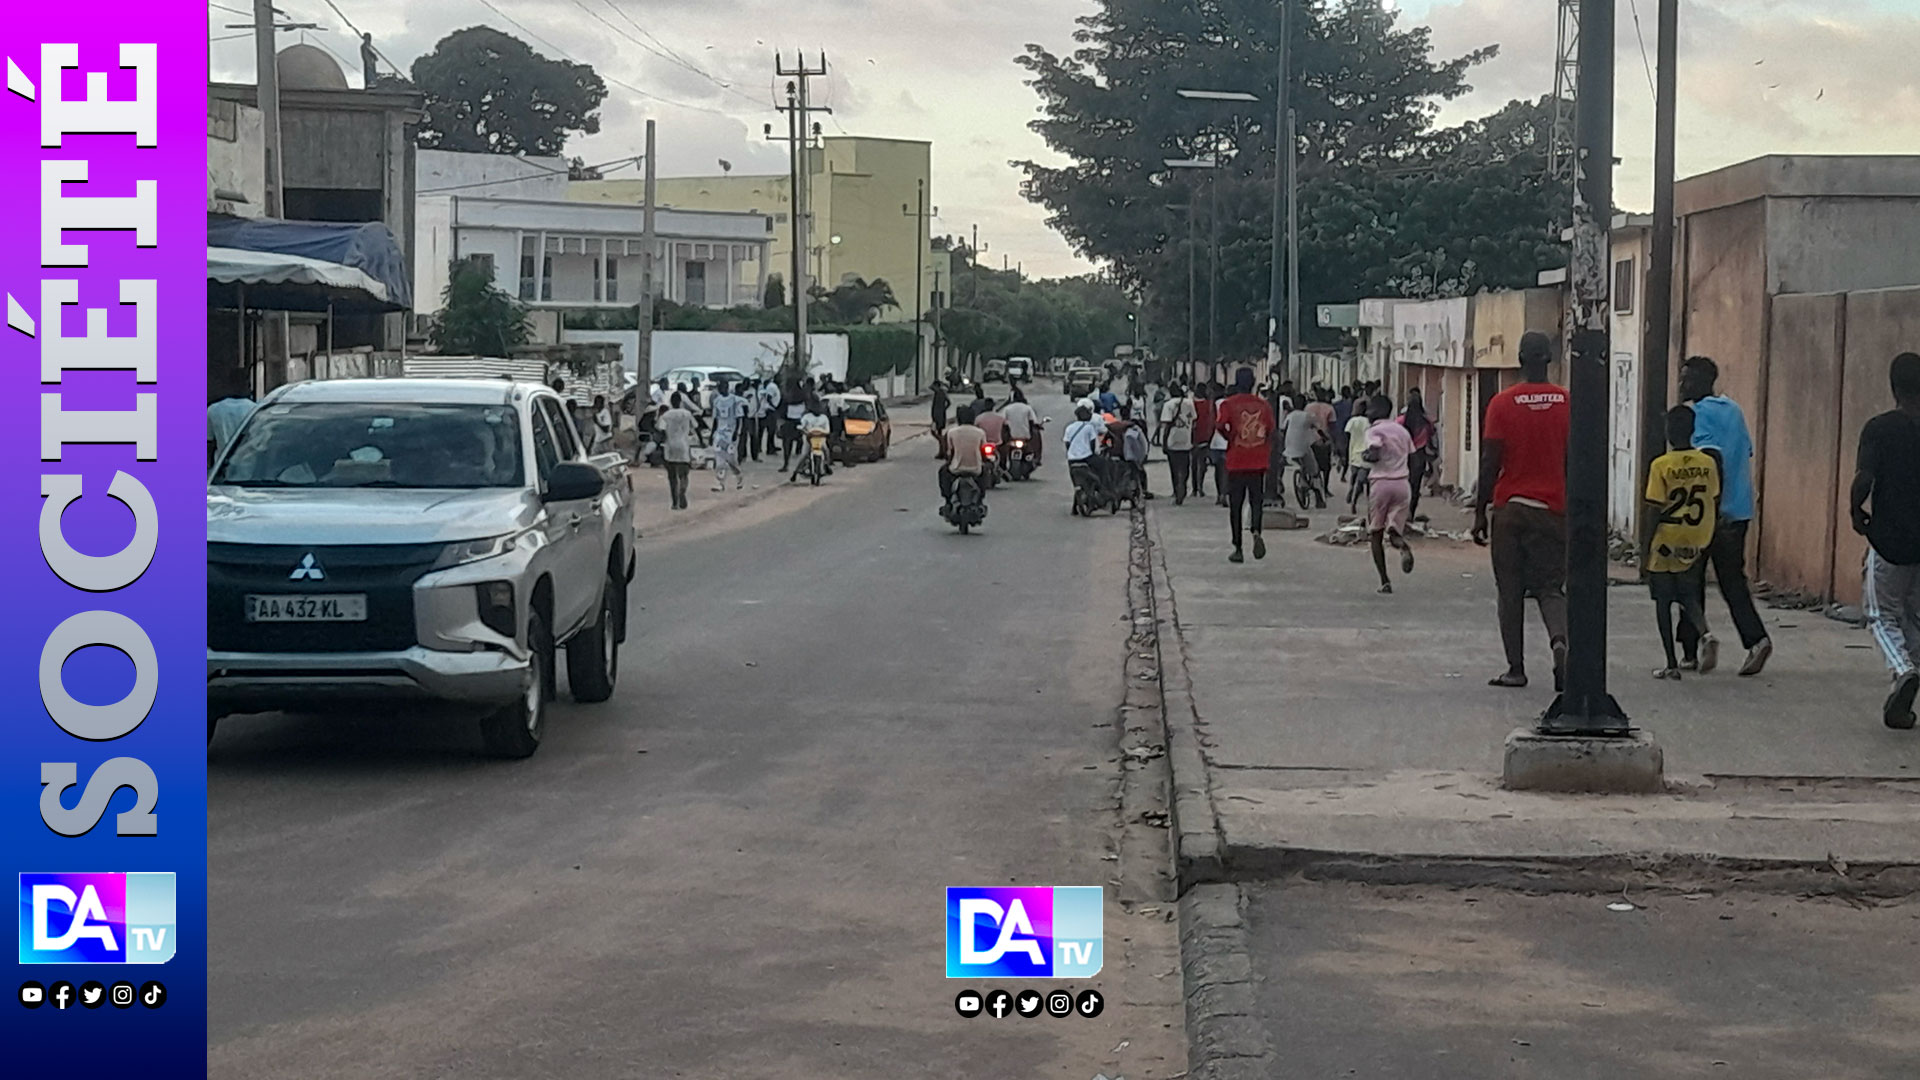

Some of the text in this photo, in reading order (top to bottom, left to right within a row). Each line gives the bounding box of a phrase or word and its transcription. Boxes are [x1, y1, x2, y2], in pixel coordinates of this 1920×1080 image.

[1514, 393, 1565, 404] VOLUNTEER
[1662, 484, 1707, 526] 25
[259, 599, 344, 618] AA 432 KL
